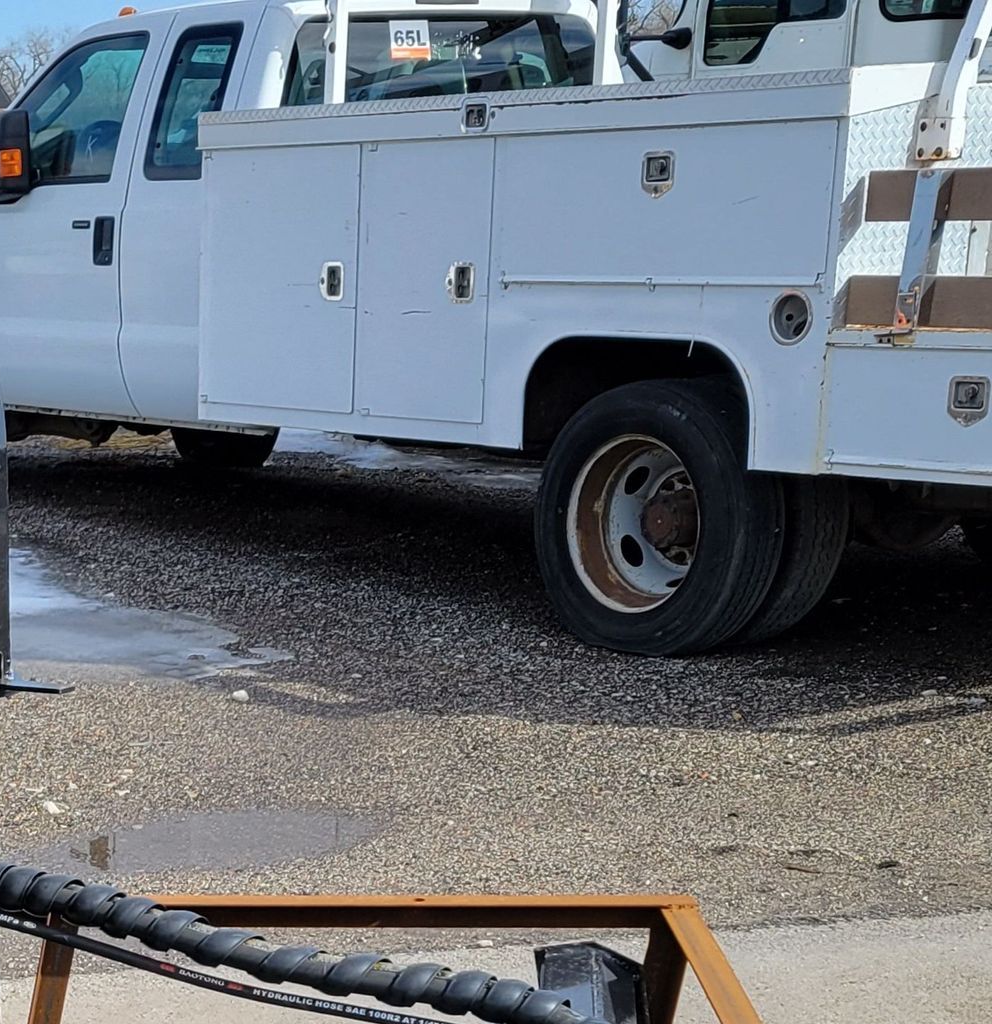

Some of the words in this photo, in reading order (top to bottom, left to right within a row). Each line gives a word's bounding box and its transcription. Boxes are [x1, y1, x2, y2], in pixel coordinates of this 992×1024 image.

[394, 30, 427, 47] 65L
[178, 969, 225, 986] BAOTONG
[253, 988, 313, 1006] HYDRAULIC
[314, 1000, 343, 1012] HOSE
[345, 1006, 366, 1016] SAE
[368, 1010, 401, 1023] 100R2
[401, 1017, 417, 1024] AT
